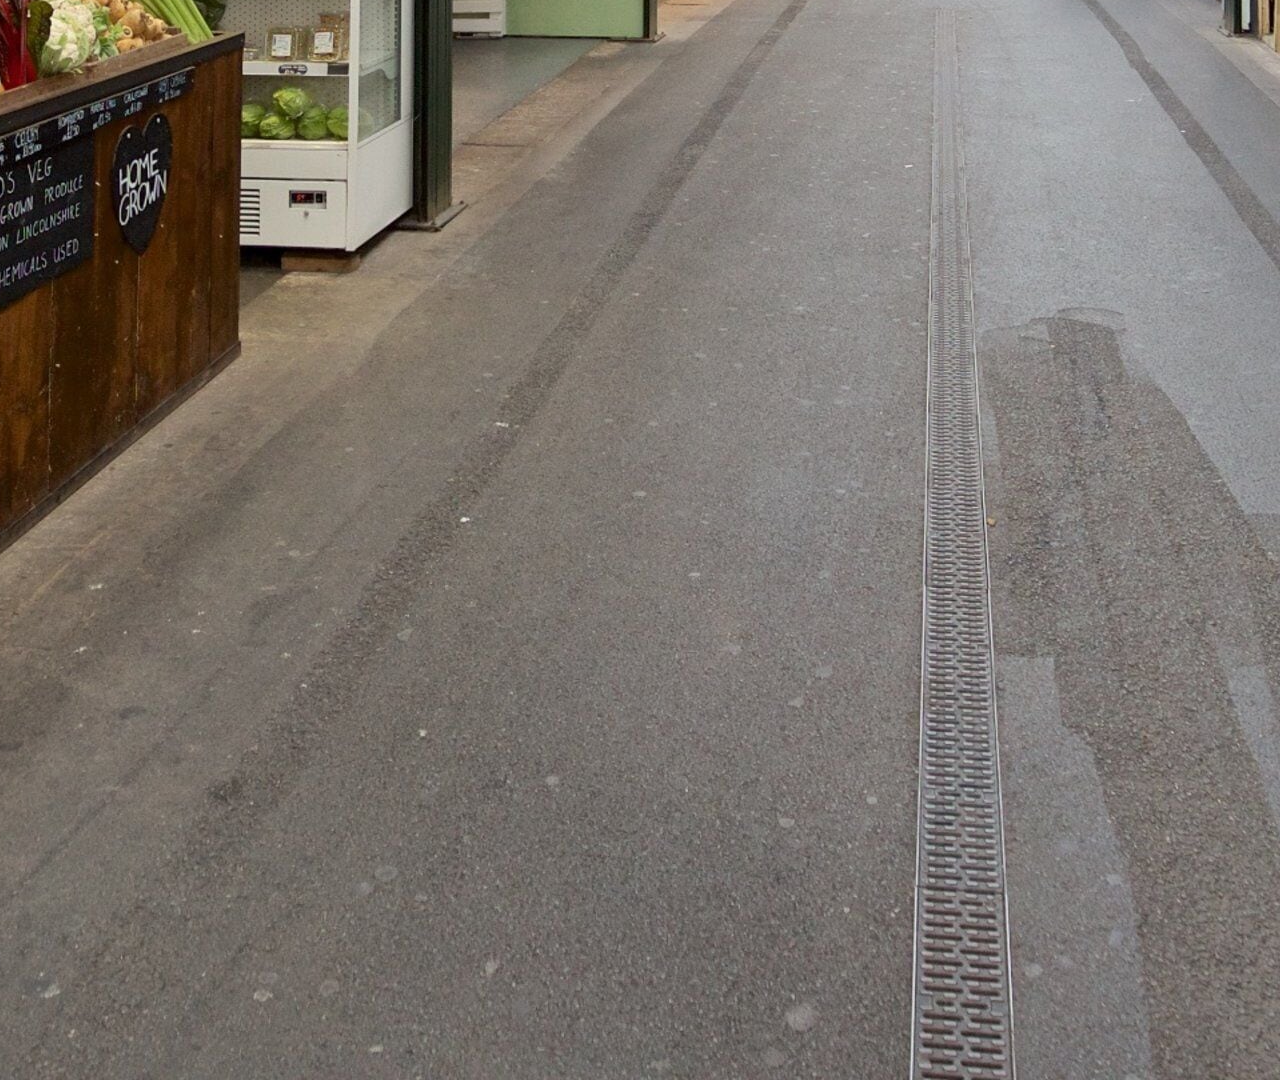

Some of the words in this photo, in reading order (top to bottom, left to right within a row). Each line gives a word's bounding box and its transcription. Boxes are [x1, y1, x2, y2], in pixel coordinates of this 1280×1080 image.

[27, 156, 53, 184] VEG
[119, 148, 159, 195] HOME
[44, 175, 84, 205] PRODUCE
[119, 170, 167, 226] GROWN
[16, 202, 81, 245] LINCOLNSHIRE
[53, 238, 80, 264] USED
